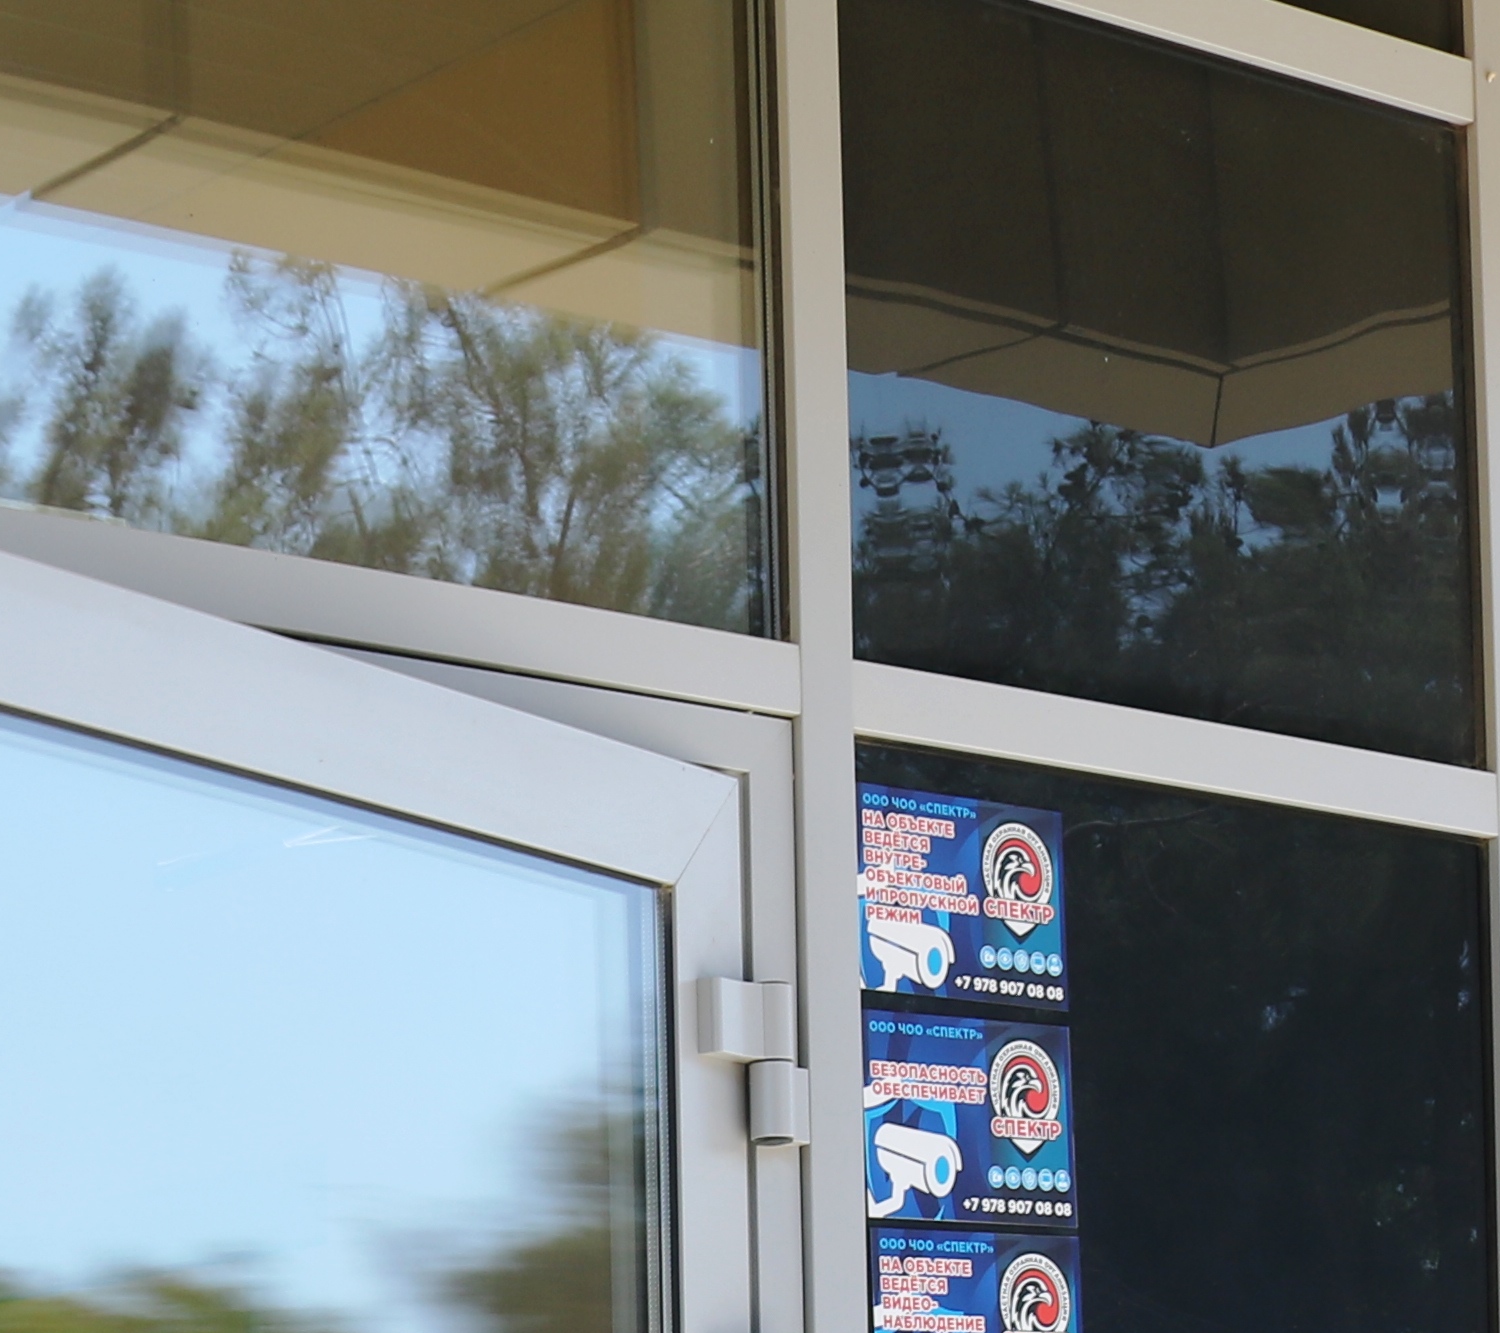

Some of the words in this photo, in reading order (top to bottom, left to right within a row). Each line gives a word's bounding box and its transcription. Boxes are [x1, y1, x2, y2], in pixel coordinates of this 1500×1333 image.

[863, 793, 889, 807] ООО
[891, 797, 916, 811] ЧОО
[919, 802, 976, 819] «СПЕКТР»
[863, 811, 885, 827] НА
[888, 815, 953, 835] ОБЪЕКТЕ
[864, 830, 929, 851] ВЕДЁТСЯ
[865, 849, 925, 868] ВНУТРЕ-
[866, 868, 965, 892] ОБЪЕКТОВЫЙ
[866, 887, 876, 899] И
[879, 888, 978, 914] ПРОПУСКНОЙ
[985, 898, 1052, 922] СПЕКТР
[867, 906, 920, 923] РЕЖИМ
[955, 975, 970, 990] +7
[974, 977, 997, 993] 978
[1000, 980, 1023, 996] 907
[1026, 983, 1044, 999] 08
[1047, 985, 1064, 1000] 08
[869, 1020, 895, 1032] ООО
[898, 1024, 923, 1035] ЧОО
[926, 1026, 983, 1040] «СПЕКТР»
[871, 1062, 986, 1083] БЕЗОПАСНОСТЬ
[872, 1083, 985, 1102] ОБЕСПЕЧИВАЕТ
[993, 1119, 1060, 1137] СПЕКТР
[963, 1197, 979, 1212] +7
[982, 1199, 1006, 1213] 978
[1009, 1200, 1032, 1214] 907
[1035, 1201, 1053, 1216] 08
[1054, 1202, 1072, 1216] 08
[880, 1238, 906, 1249] ООО
[909, 1240, 933, 1251] ЧОО
[937, 1242, 994, 1254] «СПЕКТР»
[880, 1257, 901, 1272] НА
[905, 1259, 971, 1275] ОБЪЕКТЕ
[882, 1276, 947, 1293] ВЕДЁТСЯ
[883, 1297, 937, 1313] ВИДЕО-
[883, 1315, 984, 1333] НАБЛЮДЕНИЕ
